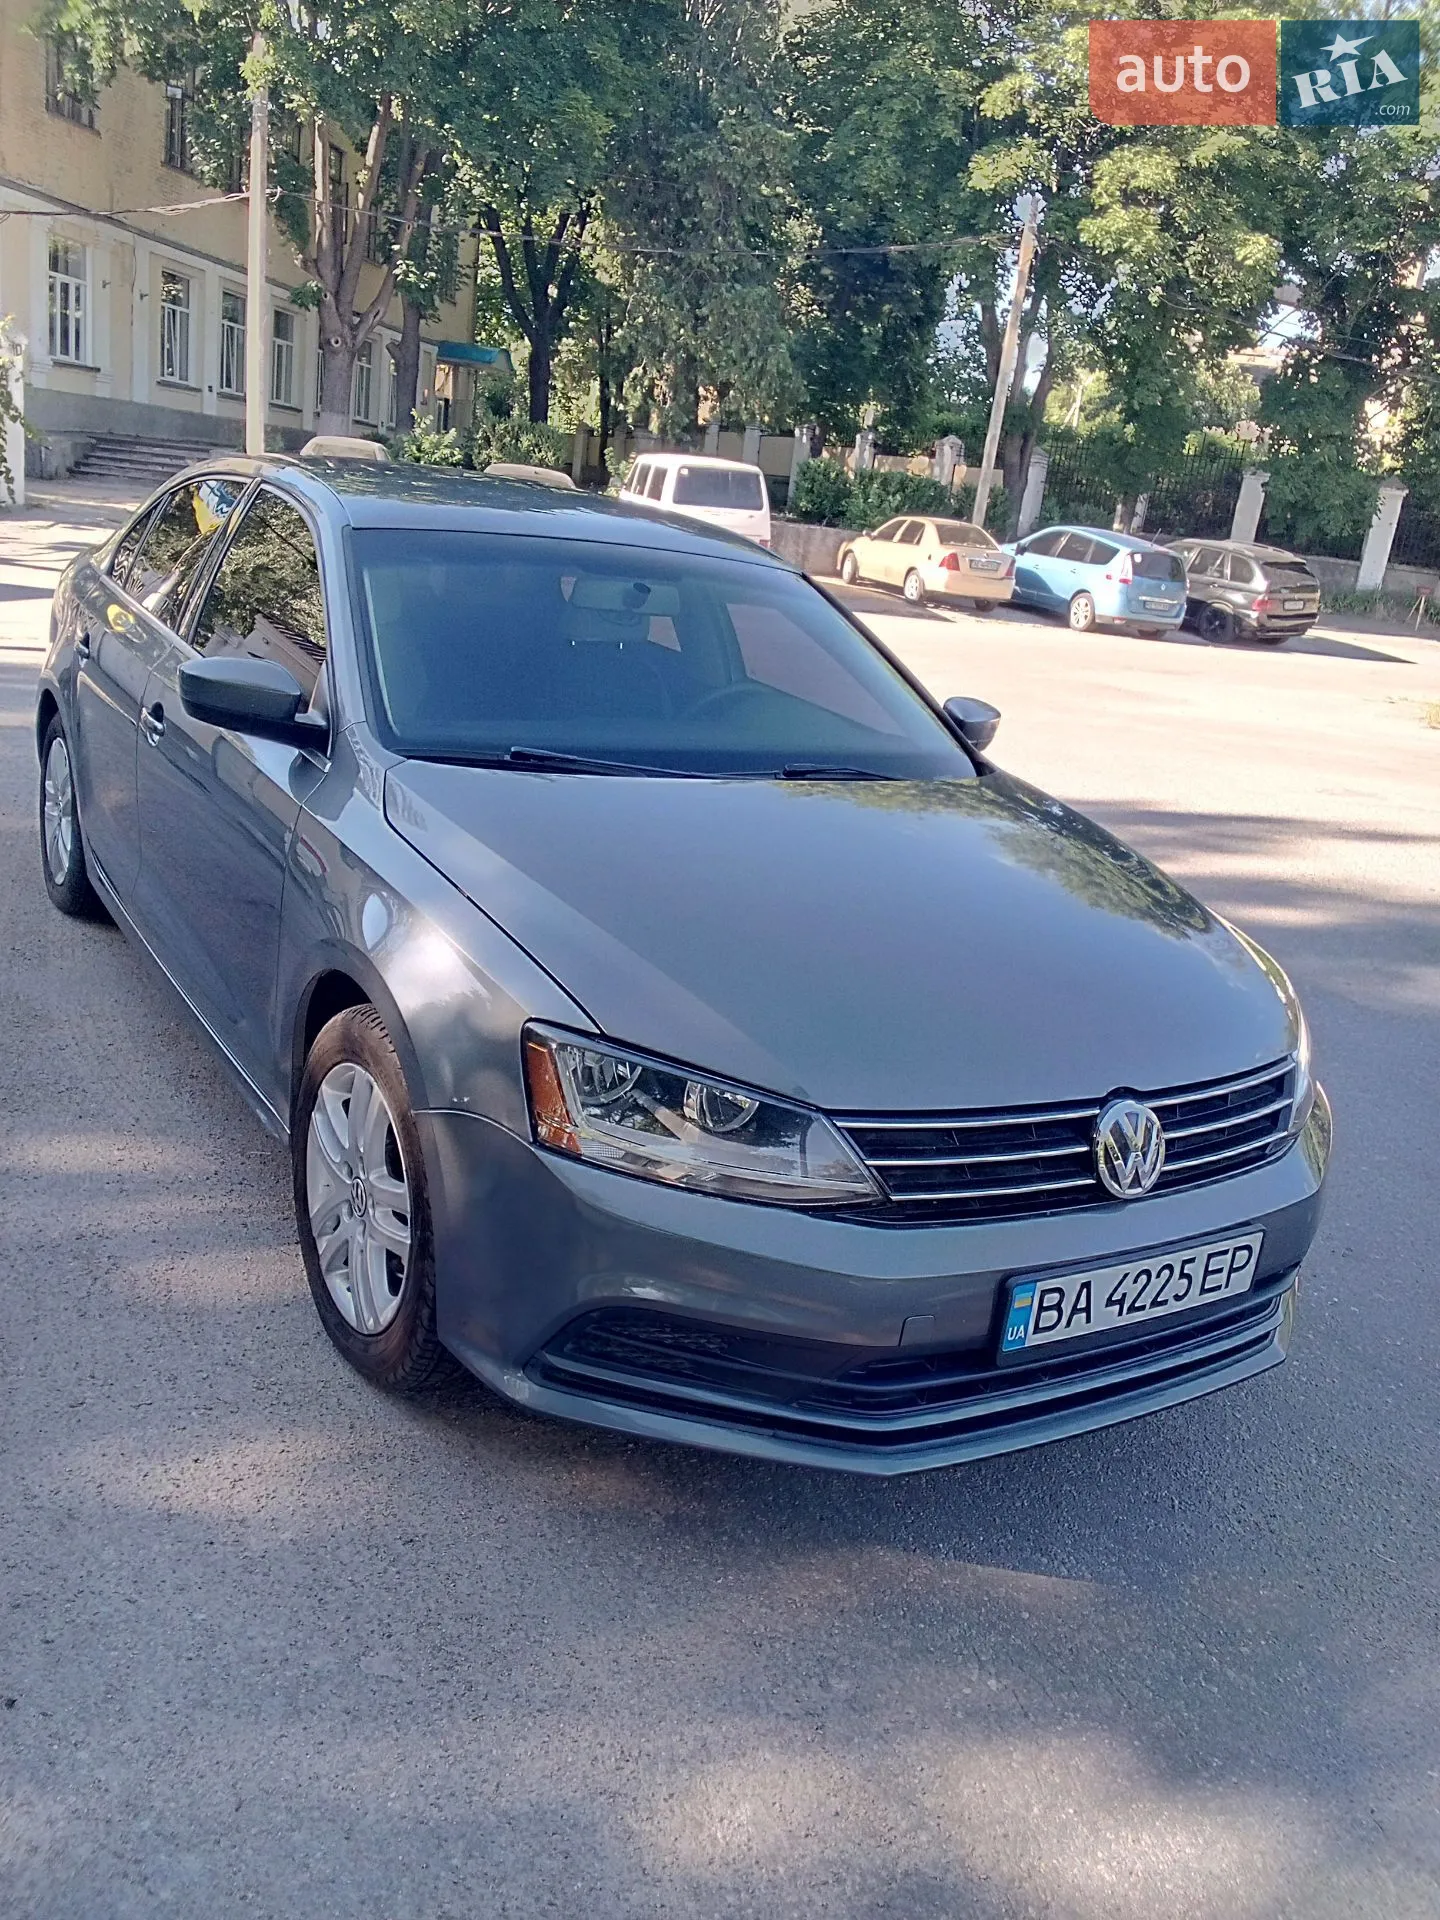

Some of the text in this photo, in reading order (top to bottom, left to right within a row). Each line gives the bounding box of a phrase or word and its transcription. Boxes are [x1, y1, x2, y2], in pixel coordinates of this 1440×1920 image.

[1032, 1244, 1254, 1335] BA 4225 EP
[1008, 1325, 1025, 1341] UA
